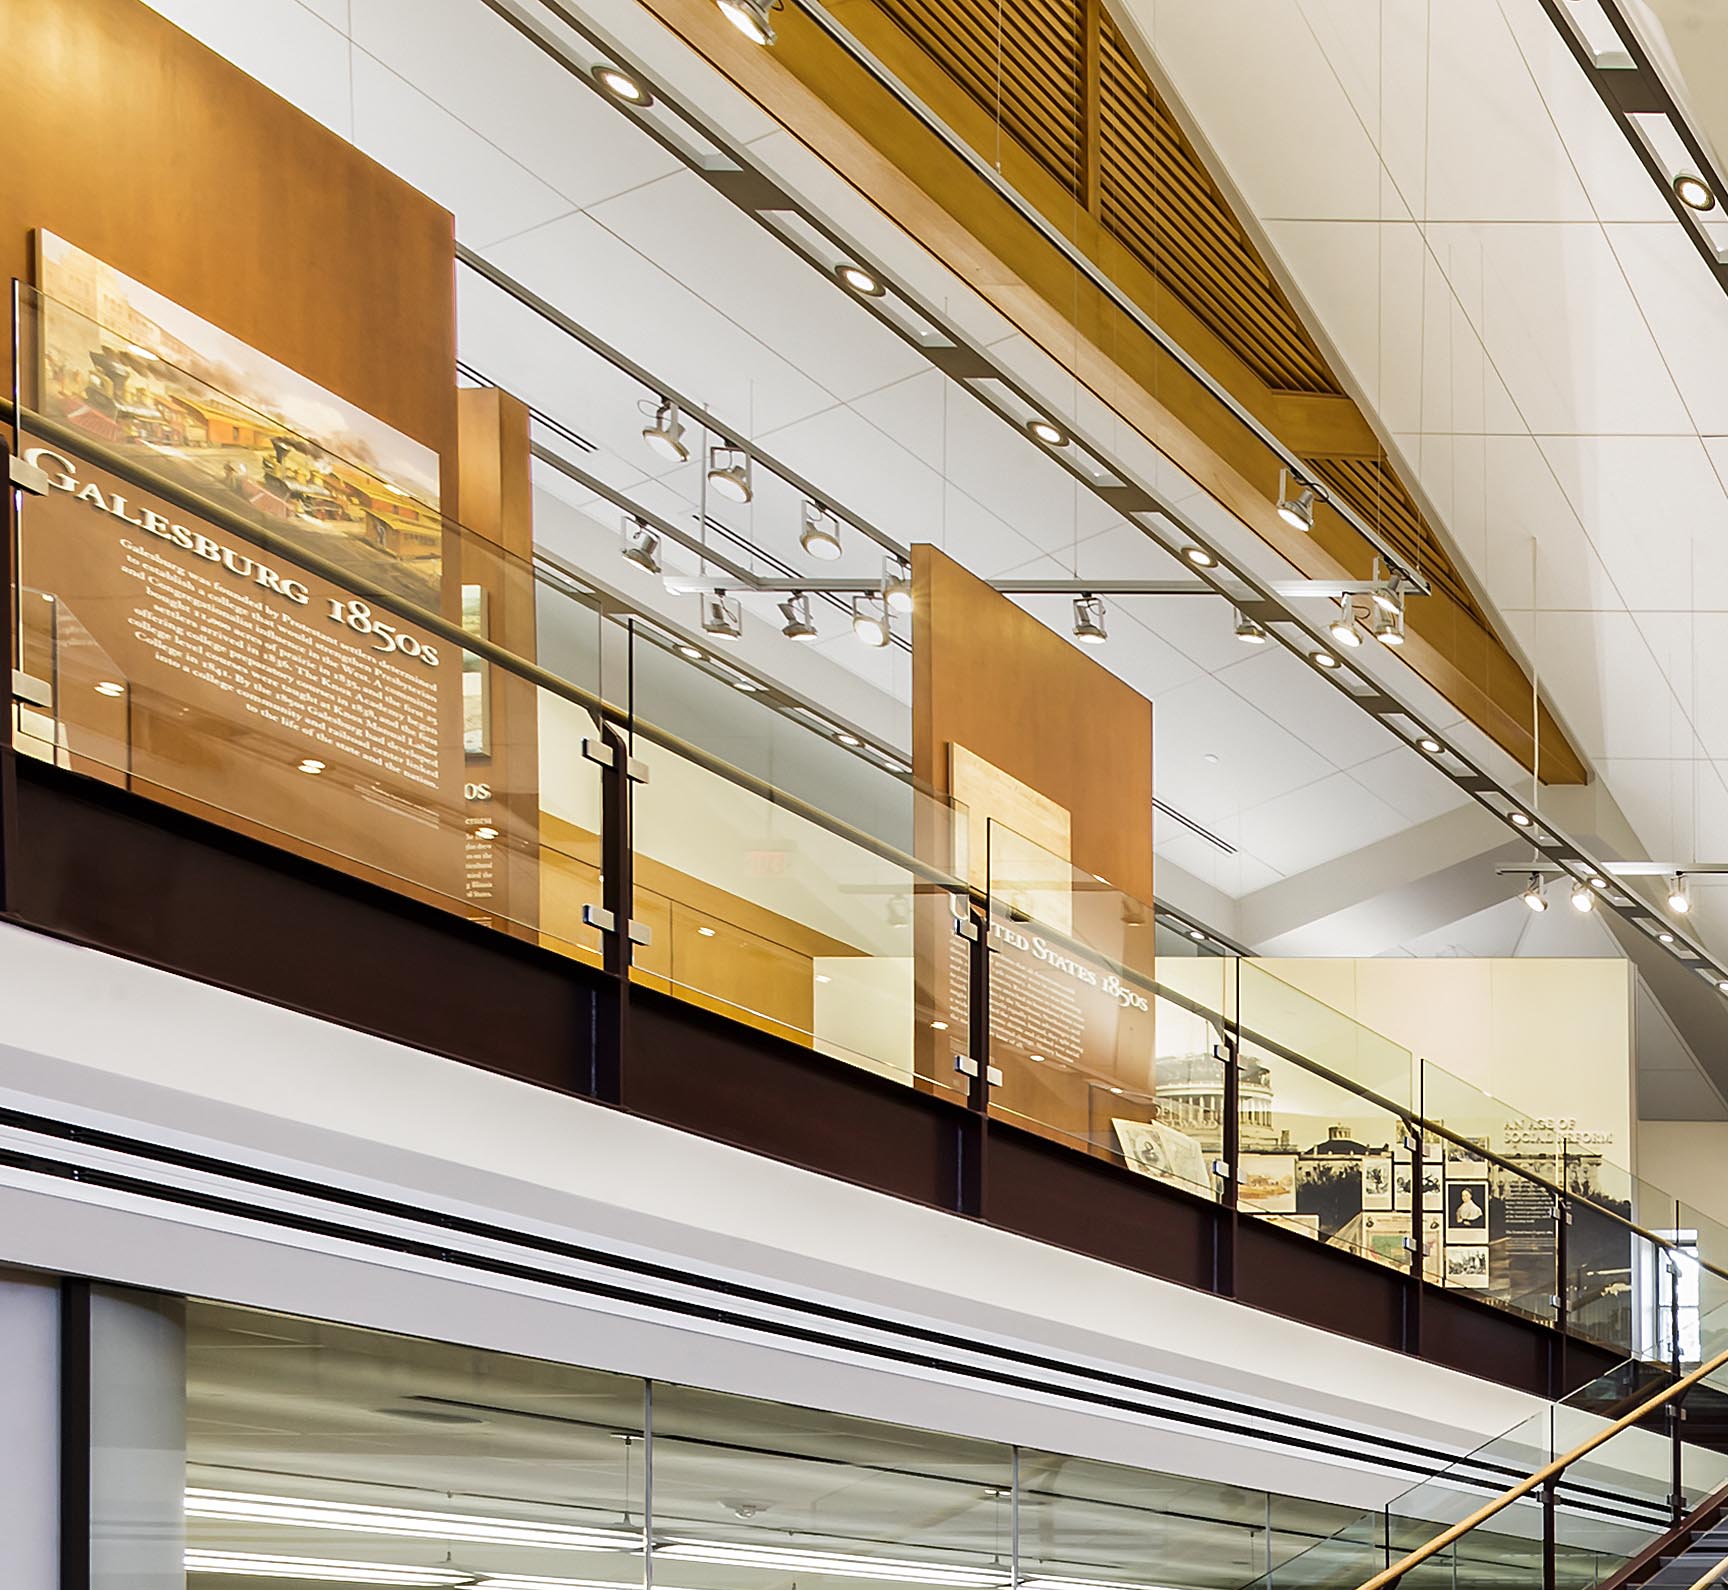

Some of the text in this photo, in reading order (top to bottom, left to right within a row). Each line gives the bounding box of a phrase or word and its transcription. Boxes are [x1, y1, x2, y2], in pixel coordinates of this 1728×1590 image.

[24, 448, 309, 604] GALESBURG
[120, 538, 437, 692] Galesburg was founded by Protestant settlers determined
[121, 565, 437, 713] and Congregationalist influence in the West. A committee
[126, 555, 140, 565] to
[142, 563, 195, 591] establish
[207, 593, 249, 616] college
[251, 612, 275, 628] that
[276, 624, 313, 645] would
[315, 642, 372, 673] strengthen
[374, 667, 437, 703] Presbyterian
[134, 608, 185, 636] offering
[186, 631, 227, 653] college
[229, 649, 294, 684] preparatory
[296, 680, 335, 701] courses
[337, 696, 349, 707] in
[378, 716, 399, 729] and
[401, 725, 417, 736] the
[418, 732, 438, 746] first
[146, 586, 191, 613] bought
[233, 628, 263, 646] acres
[264, 642, 277, 652] of
[279, 648, 317, 669] prairie
[319, 665, 331, 676] in
[362, 687, 383, 700] and
[384, 696, 401, 708] the
[403, 704, 423, 718] first
[153, 604, 198, 628] settlers
[200, 625, 244, 649] arrived
[246, 643, 259, 656] in
[297, 665, 319, 682] The
[321, 676, 352, 697] Knox
[355, 693, 405, 721] Academy
[407, 715, 438, 735] began
[127, 618, 438, 756] college level courses were taught at Knox Manual Labor
[1032, 937, 1097, 986] STATES
[1504, 1117, 1577, 1131] AN AGE OF
[1504, 1132, 1555, 1145] SOCIAL
